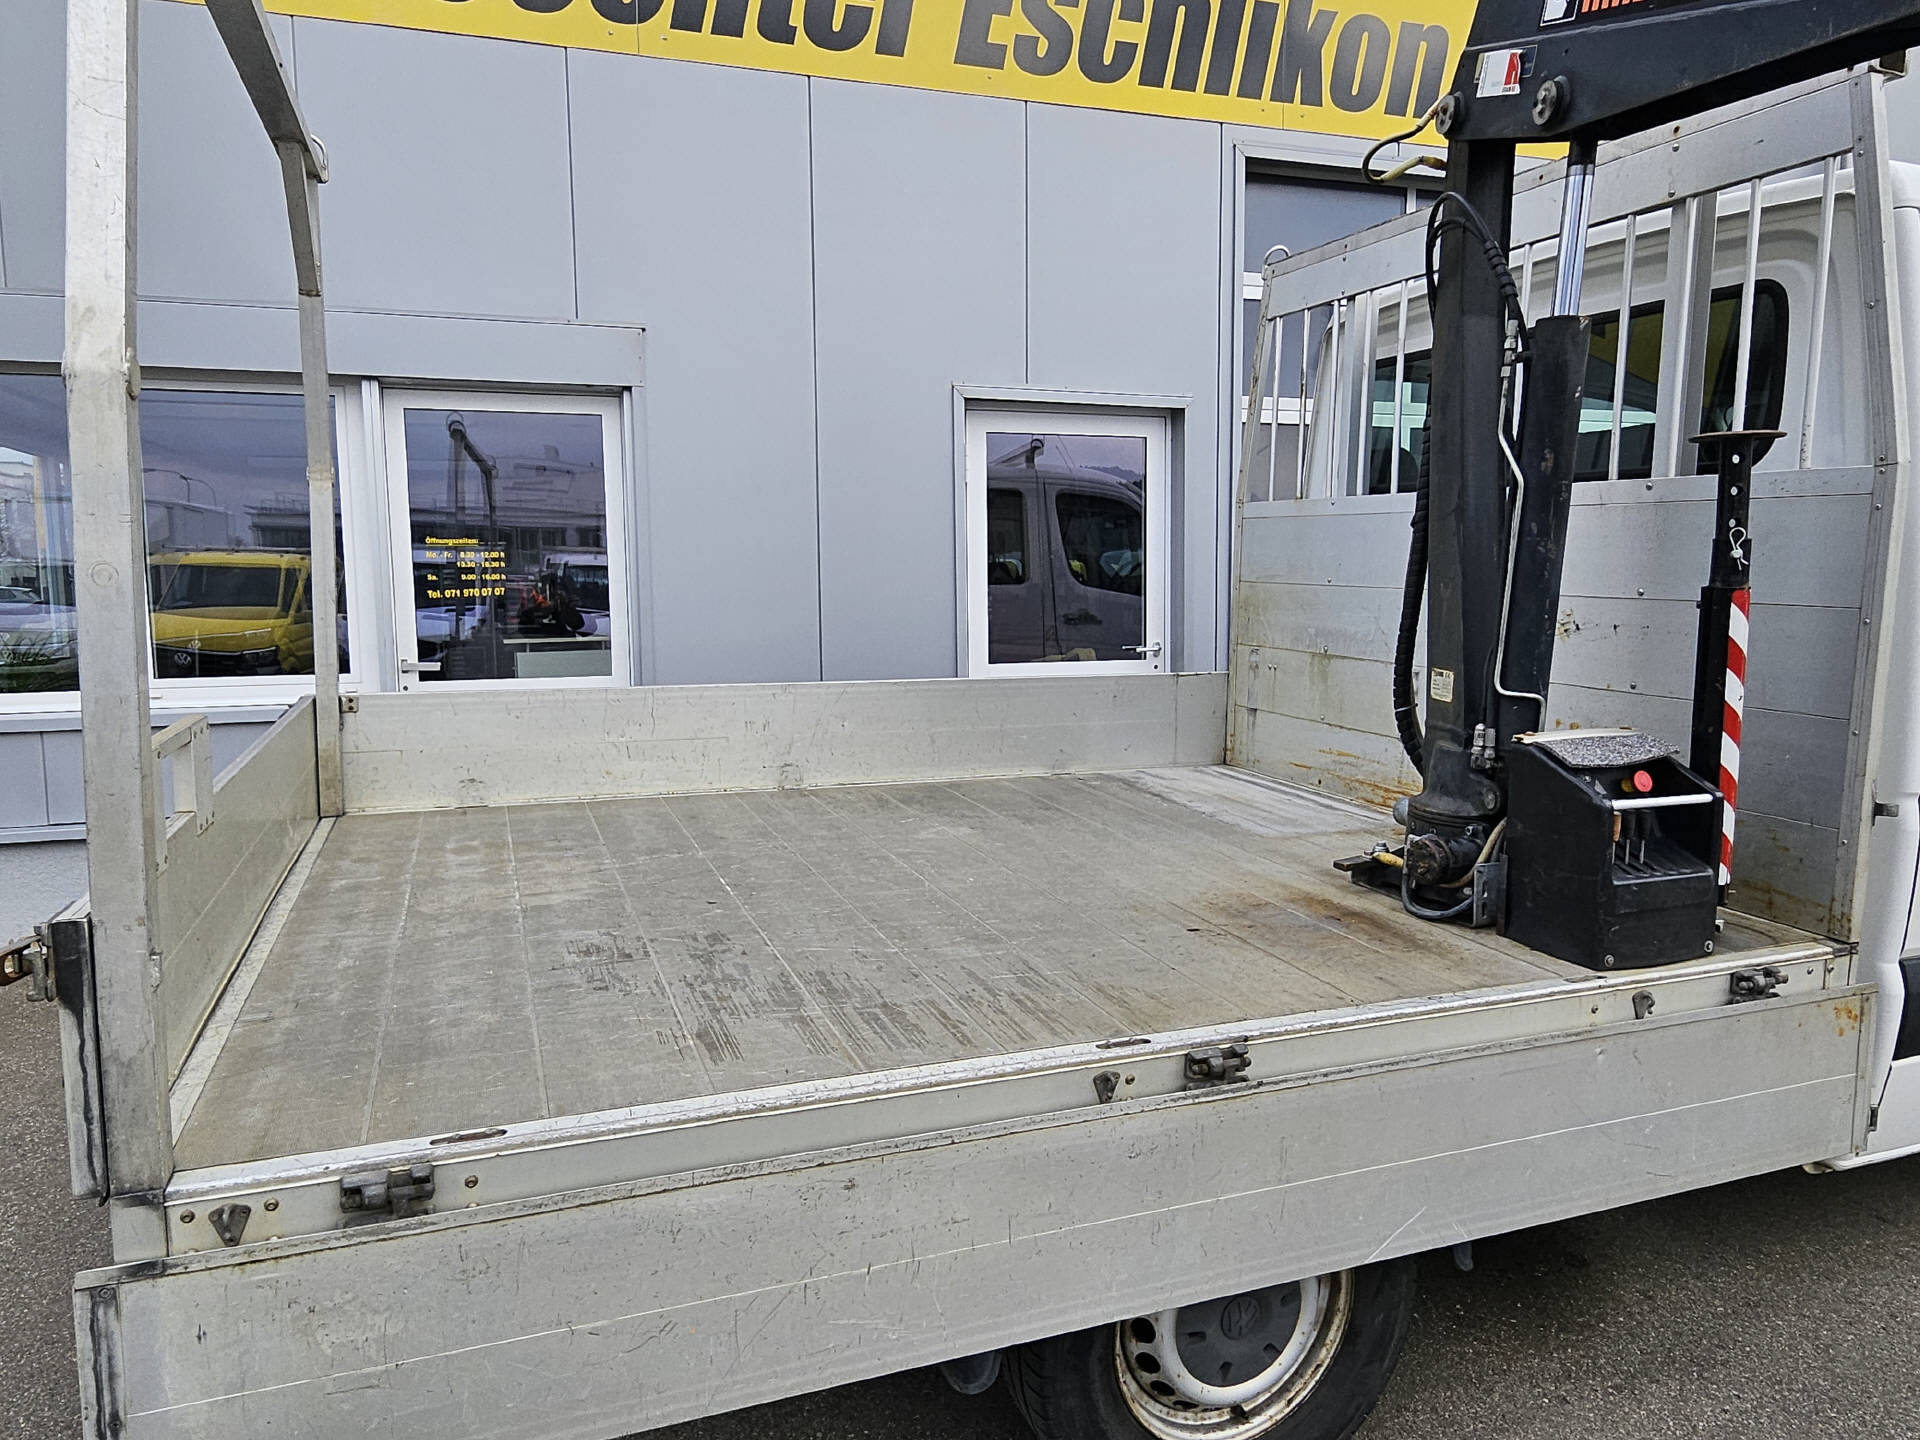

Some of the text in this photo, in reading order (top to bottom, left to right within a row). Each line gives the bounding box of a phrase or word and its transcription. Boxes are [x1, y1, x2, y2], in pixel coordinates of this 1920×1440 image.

[425, 536, 479, 546] Öffnungszeiten:
[427, 587, 506, 599] Tel. 071 970 07 07
